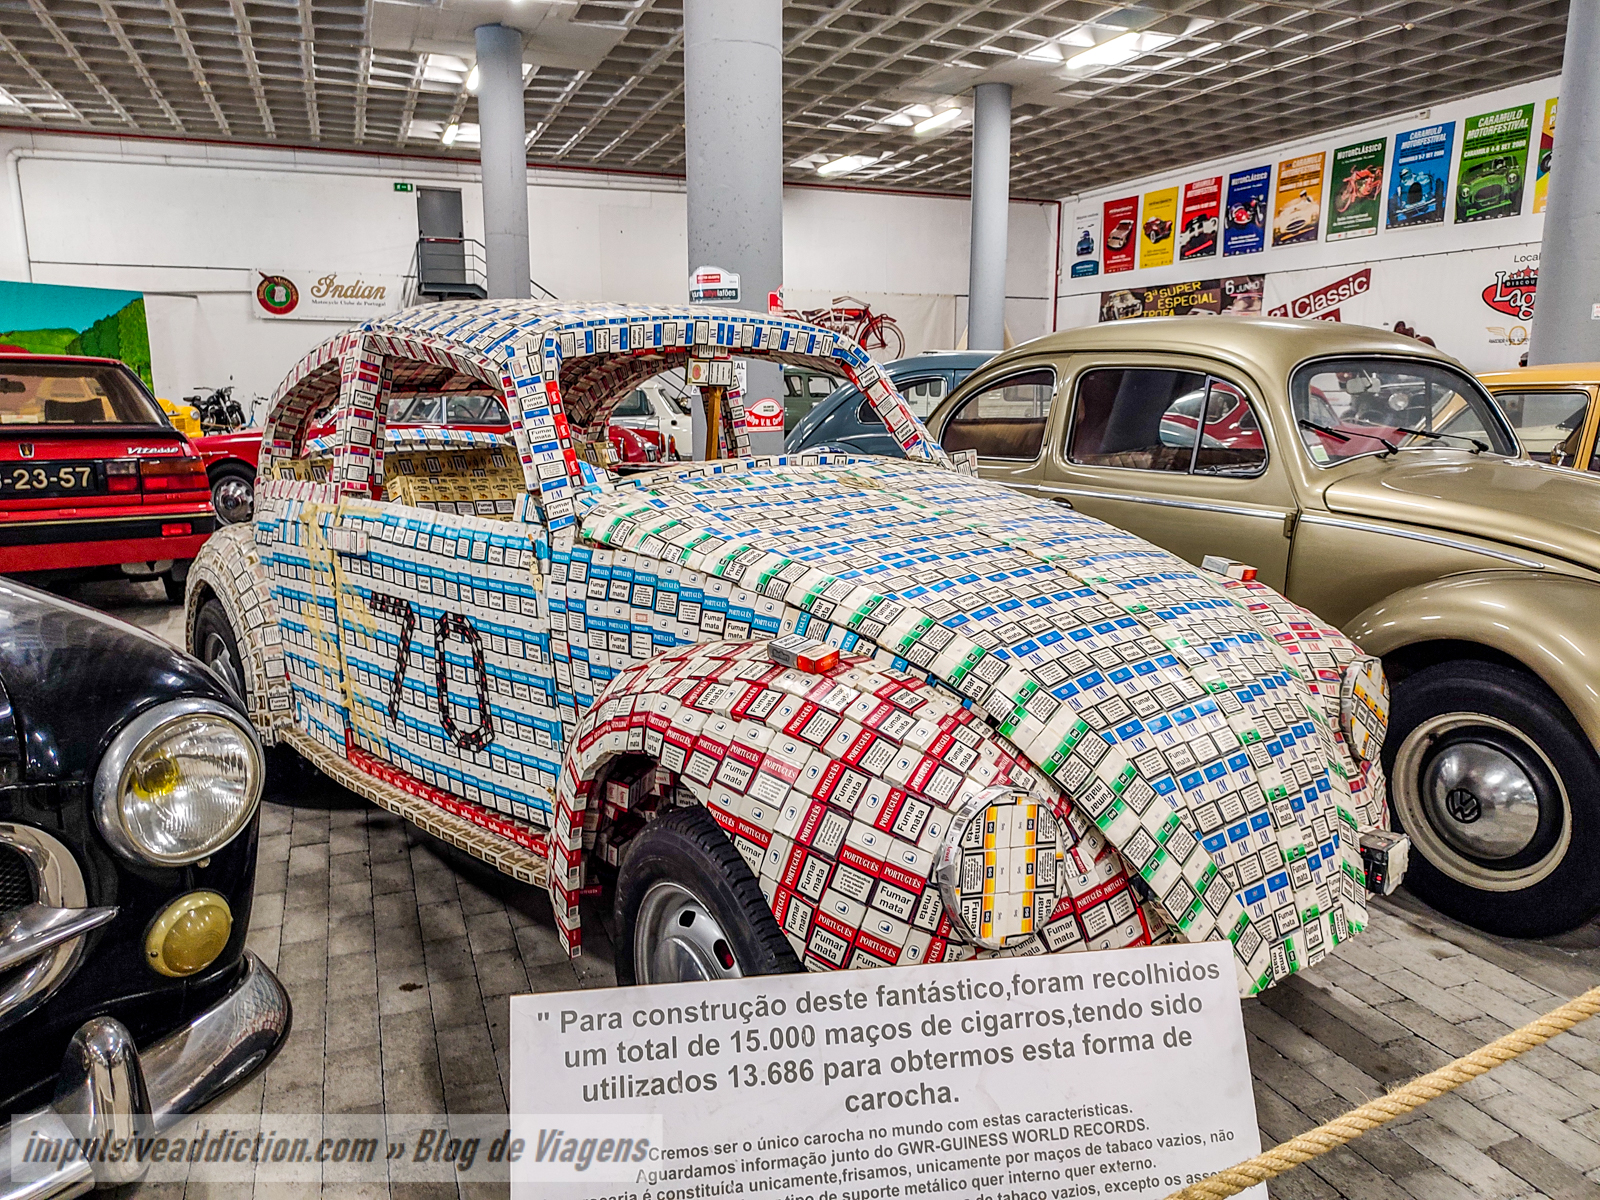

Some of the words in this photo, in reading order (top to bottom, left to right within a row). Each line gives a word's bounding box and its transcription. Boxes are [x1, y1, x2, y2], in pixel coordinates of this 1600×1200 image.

[1466, 118, 1529, 140] MOTORFESTIVAL
[1478, 109, 1523, 128] CARAMULO
[1401, 133, 1447, 150] MOTORFESTIVAL
[1409, 126, 1443, 140] CARAMULO
[310, 274, 387, 300] Indian
[1159, 281, 1202, 298] SUPER
[1225, 279, 1236, 295] 6
[1236, 280, 1260, 293] JUNHO
[1294, 277, 1368, 318] Classic
[1157, 293, 1218, 309] ESPECIAL
[127, 446, 179, 455] Vitesse
[0, 467, 91, 490] -23-57
[591, 580, 606, 588] Fumar
[704, 614, 723, 622] Fumar
[705, 622, 719, 630] mata
[727, 622, 747, 632] Fumar
[751, 691, 770, 713] Fumar
[762, 696, 777, 713] mata
[883, 713, 903, 733] Fumar
[1168, 747, 1187, 759] Fumar
[723, 772, 742, 786] mata
[725, 762, 749, 778] Fumar
[834, 773, 854, 803] Fumar
[846, 781, 862, 808] mata
[897, 801, 916, 832] Fumar
[910, 808, 925, 834] mata
[843, 848, 880, 872] PORTUGUÊS
[801, 859, 817, 891] Fumar
[812, 869, 825, 898] mata
[884, 866, 922, 890] PORTUGUÊS
[879, 898, 904, 915] mata
[880, 885, 912, 906] Fumar
[818, 914, 853, 938] PORTUGUÊS
[1278, 909, 1294, 921] Fumar
[1047, 920, 1074, 935] Fumar
[1054, 931, 1075, 945] mata
[814, 930, 845, 952] Fumar
[814, 942, 838, 960] mata
[859, 935, 896, 958] PORTUGUÊS
[561, 1011, 622, 1033] Para
[633, 996, 787, 1027] construção
[796, 989, 867, 1013] deste
[1093, 963, 1219, 989] recolhidos
[565, 1048, 606, 1067] um
[617, 1036, 677, 1063] total
[688, 1034, 719, 1057] de
[731, 1025, 815, 1052] 15.000
[826, 1022, 911, 1047] maços
[922, 1014, 951, 1036] de
[1151, 993, 1202, 1016] sido
[583, 1070, 717, 1102] utilizados
[728, 1059, 813, 1087] 13.686
[824, 1059, 881, 1085] para
[891, 1047, 1013, 1073] obtermos
[1023, 1038, 1075, 1061] esta
[1082, 1034, 1154, 1055] forma
[1163, 1026, 1191, 1048] de
[846, 1082, 959, 1113] carocha.
[649, 1146, 708, 1160] Cremos
[714, 1143, 738, 1154] ser
[743, 1142, 752, 1151] o
[758, 1136, 799, 1150] único
[804, 1129, 864, 1145] carocha
[869, 1128, 887, 1139] no
[892, 1120, 942, 1136] mundo
[948, 1119, 978, 1131] com
[983, 1114, 1020, 1127] estas
[1026, 1103, 1134, 1124] características.
[636, 1163, 735, 1185] Aguardamos
[741, 1152, 826, 1172] informação
[831, 1149, 869, 1166] junto
[875, 1145, 892, 1158] do
[898, 1132, 1008, 1155] GWR-GUINESS
[1012, 1127, 1069, 1143] WORLD
[1074, 1119, 1150, 1138] RECORDS.
[917, 1154, 1000, 1173] unicamente
[1006, 1153, 1029, 1167] por
[1034, 1148, 1080, 1162] maços
[1085, 1143, 1101, 1155] de
[1106, 1140, 1152, 1153] tabaco
[1157, 1135, 1205, 1147] vazios,
[1210, 1128, 1235, 1143] não
[905, 1179, 967, 1195] metálico
[972, 1175, 1004, 1190] quer
[1009, 1170, 1060, 1183] interno
[1065, 1165, 1095, 1181] quer
[1100, 1159, 1157, 1174] externo.
[1052, 1184, 1100, 1199] vazios,
[1105, 1177, 1159, 1193] excepto
[1165, 1176, 1181, 1186] os
